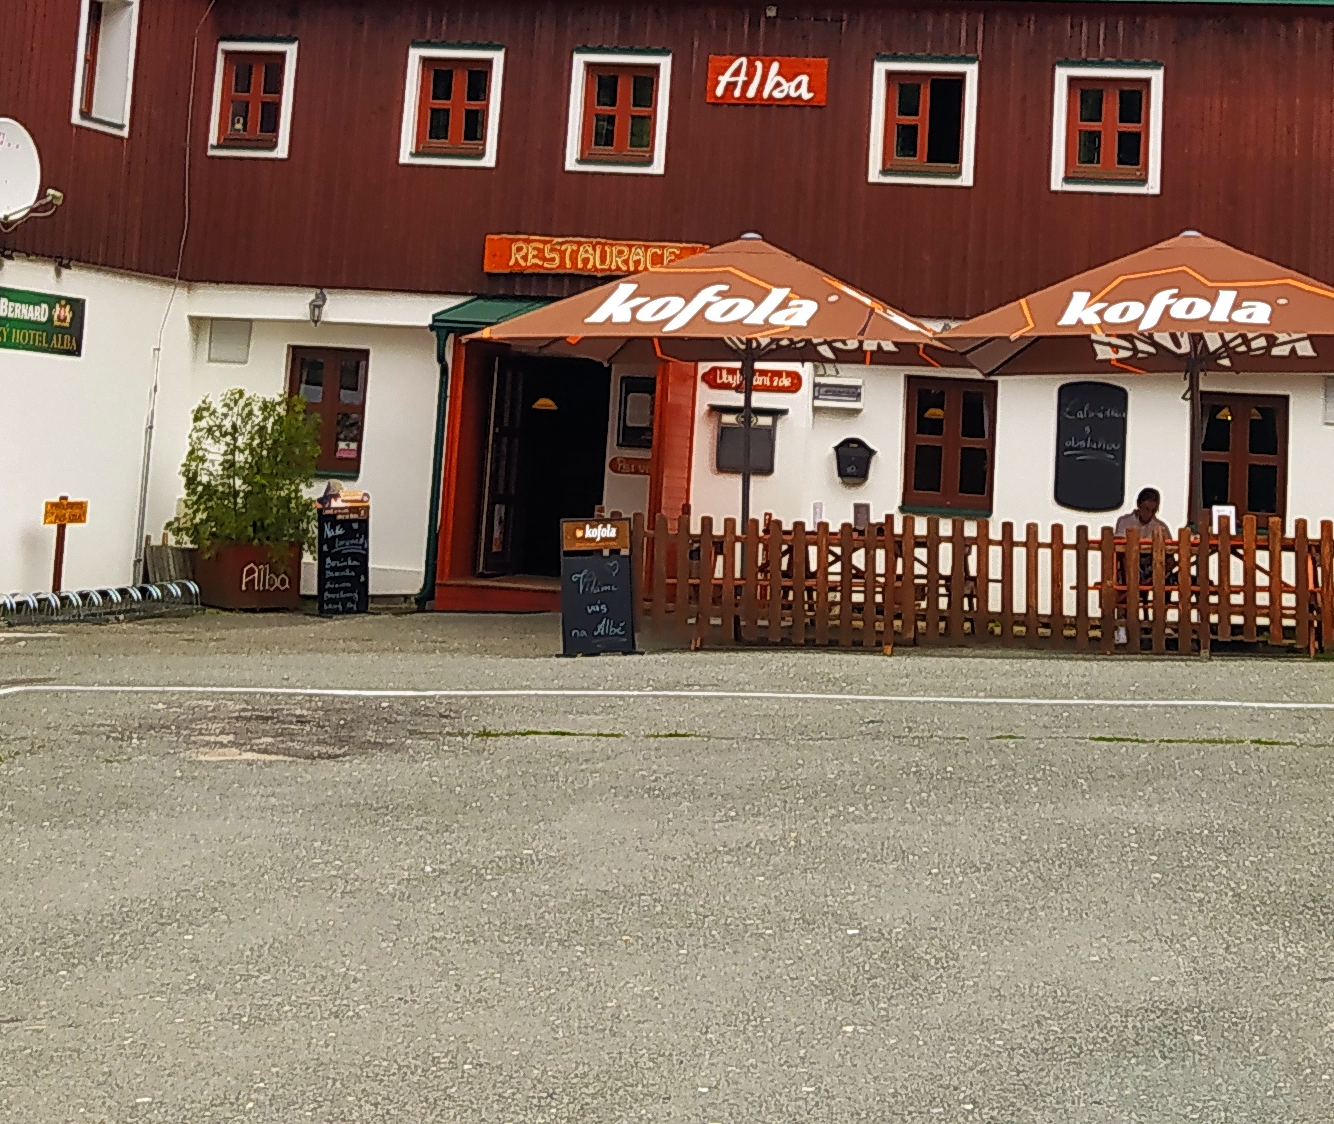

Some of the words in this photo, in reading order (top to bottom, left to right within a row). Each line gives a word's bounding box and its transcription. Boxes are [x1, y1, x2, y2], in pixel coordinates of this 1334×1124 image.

[715, 57, 815, 101] Alba
[509, 242, 680, 271] RESTAURACE
[0, 297, 48, 322] BERNARD
[584, 283, 818, 333] kofola
[1057, 288, 1272, 332] kofola
[11, 328, 48, 347] HOTEL
[50, 333, 77, 351] ALBA
[584, 523, 617, 542] kofola
[241, 562, 290, 592] Alba
